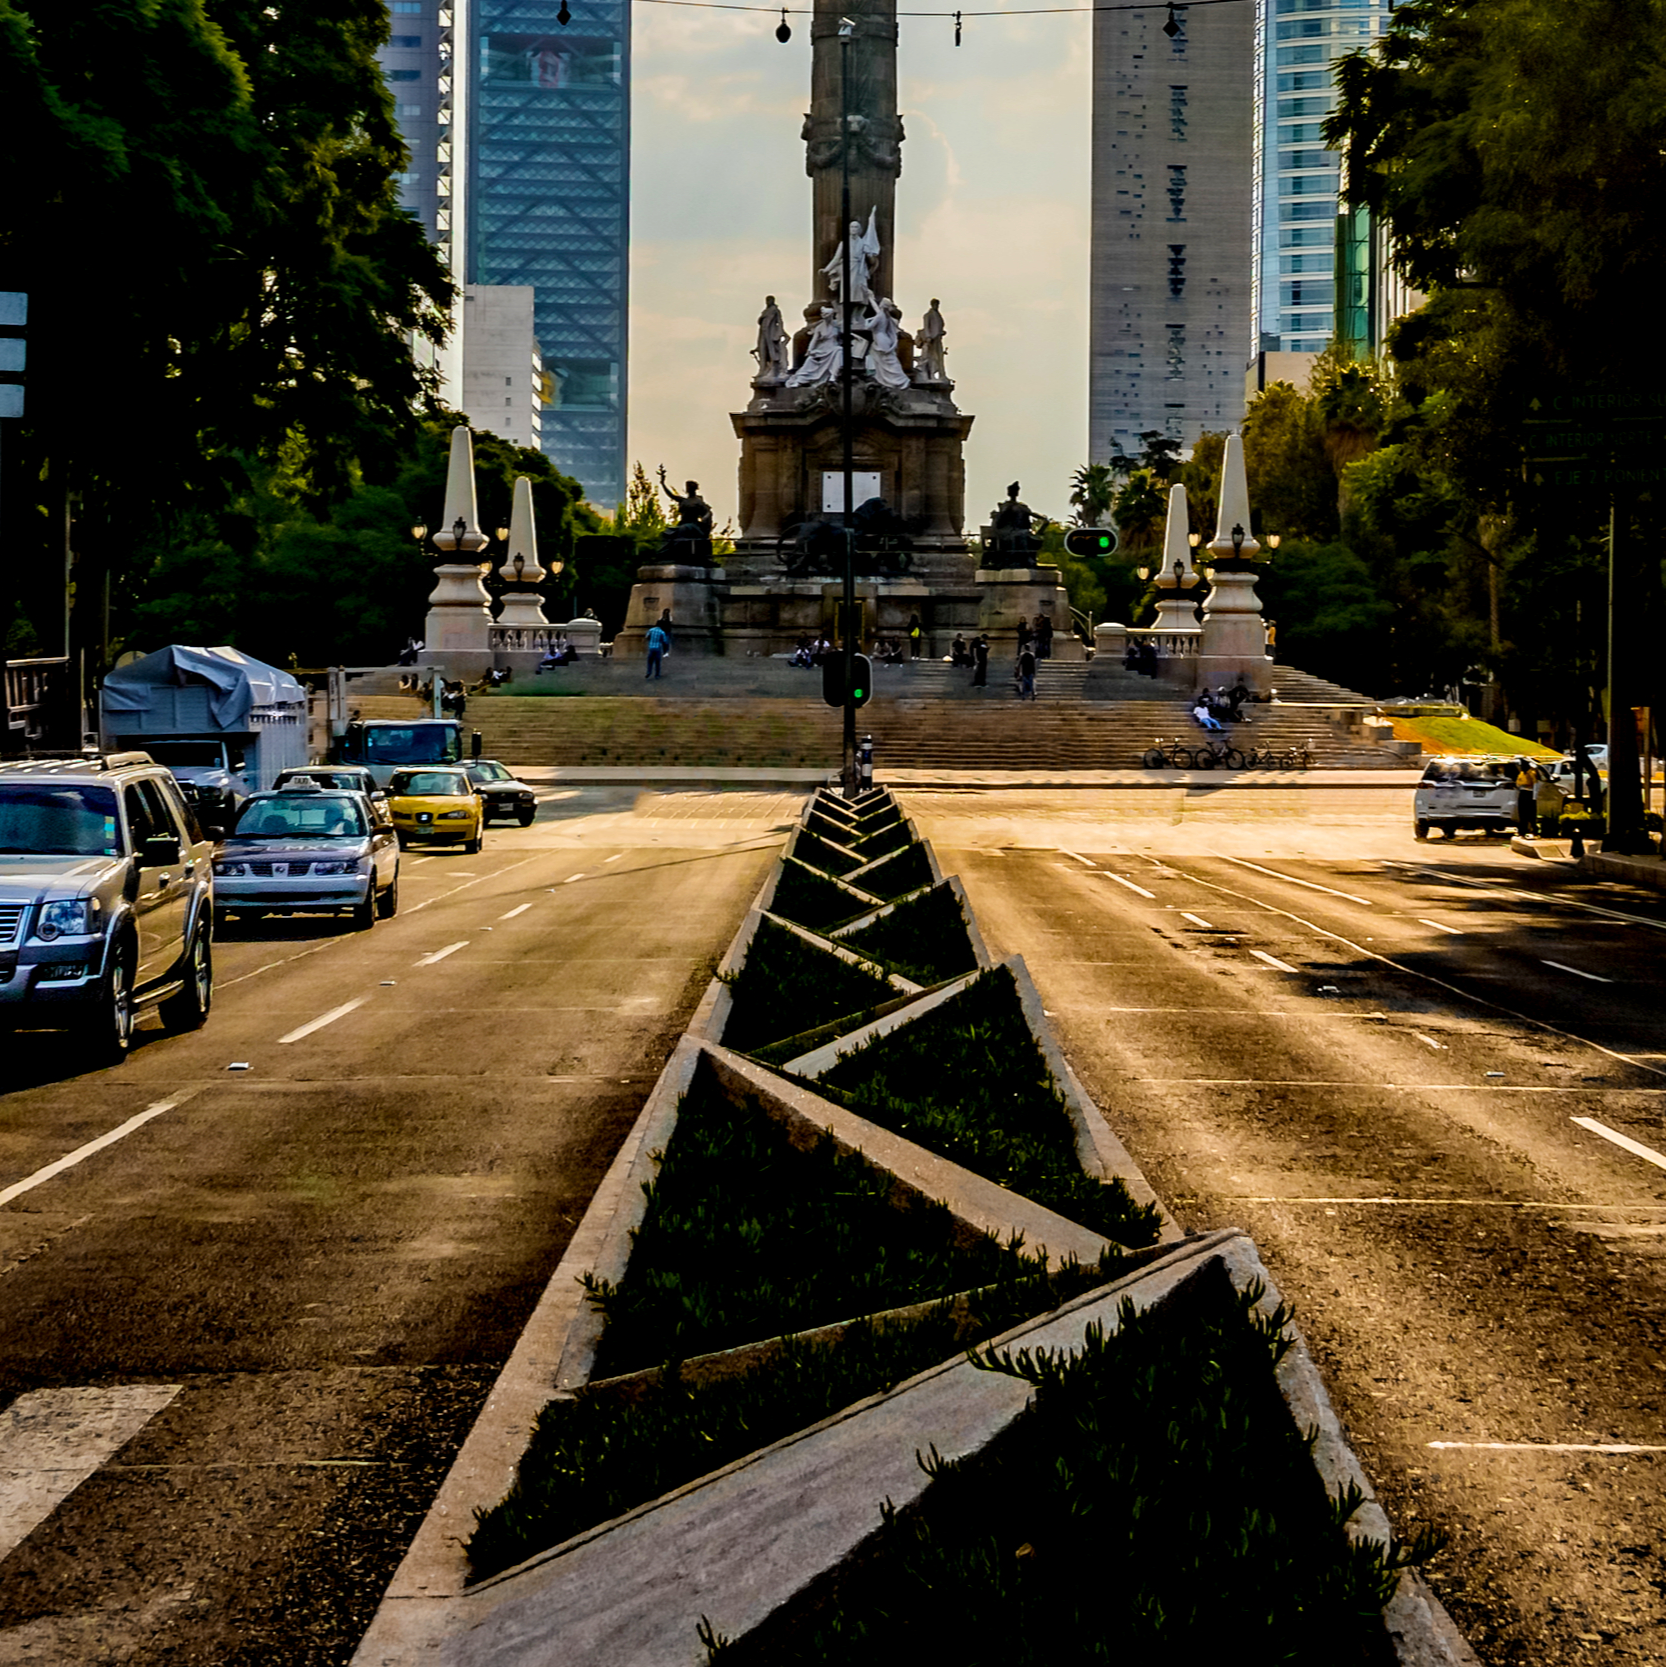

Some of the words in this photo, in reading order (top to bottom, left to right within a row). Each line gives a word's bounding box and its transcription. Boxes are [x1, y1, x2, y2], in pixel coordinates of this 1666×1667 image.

[1570, 393, 1643, 410] INTERIOR
[1545, 432, 1606, 448] INTERIOR
[1610, 430, 1653, 445] NORTE
[1554, 469, 1583, 486] EJE
[1589, 470, 1598, 485] 2
[294, 777, 308, 785] TAXI
